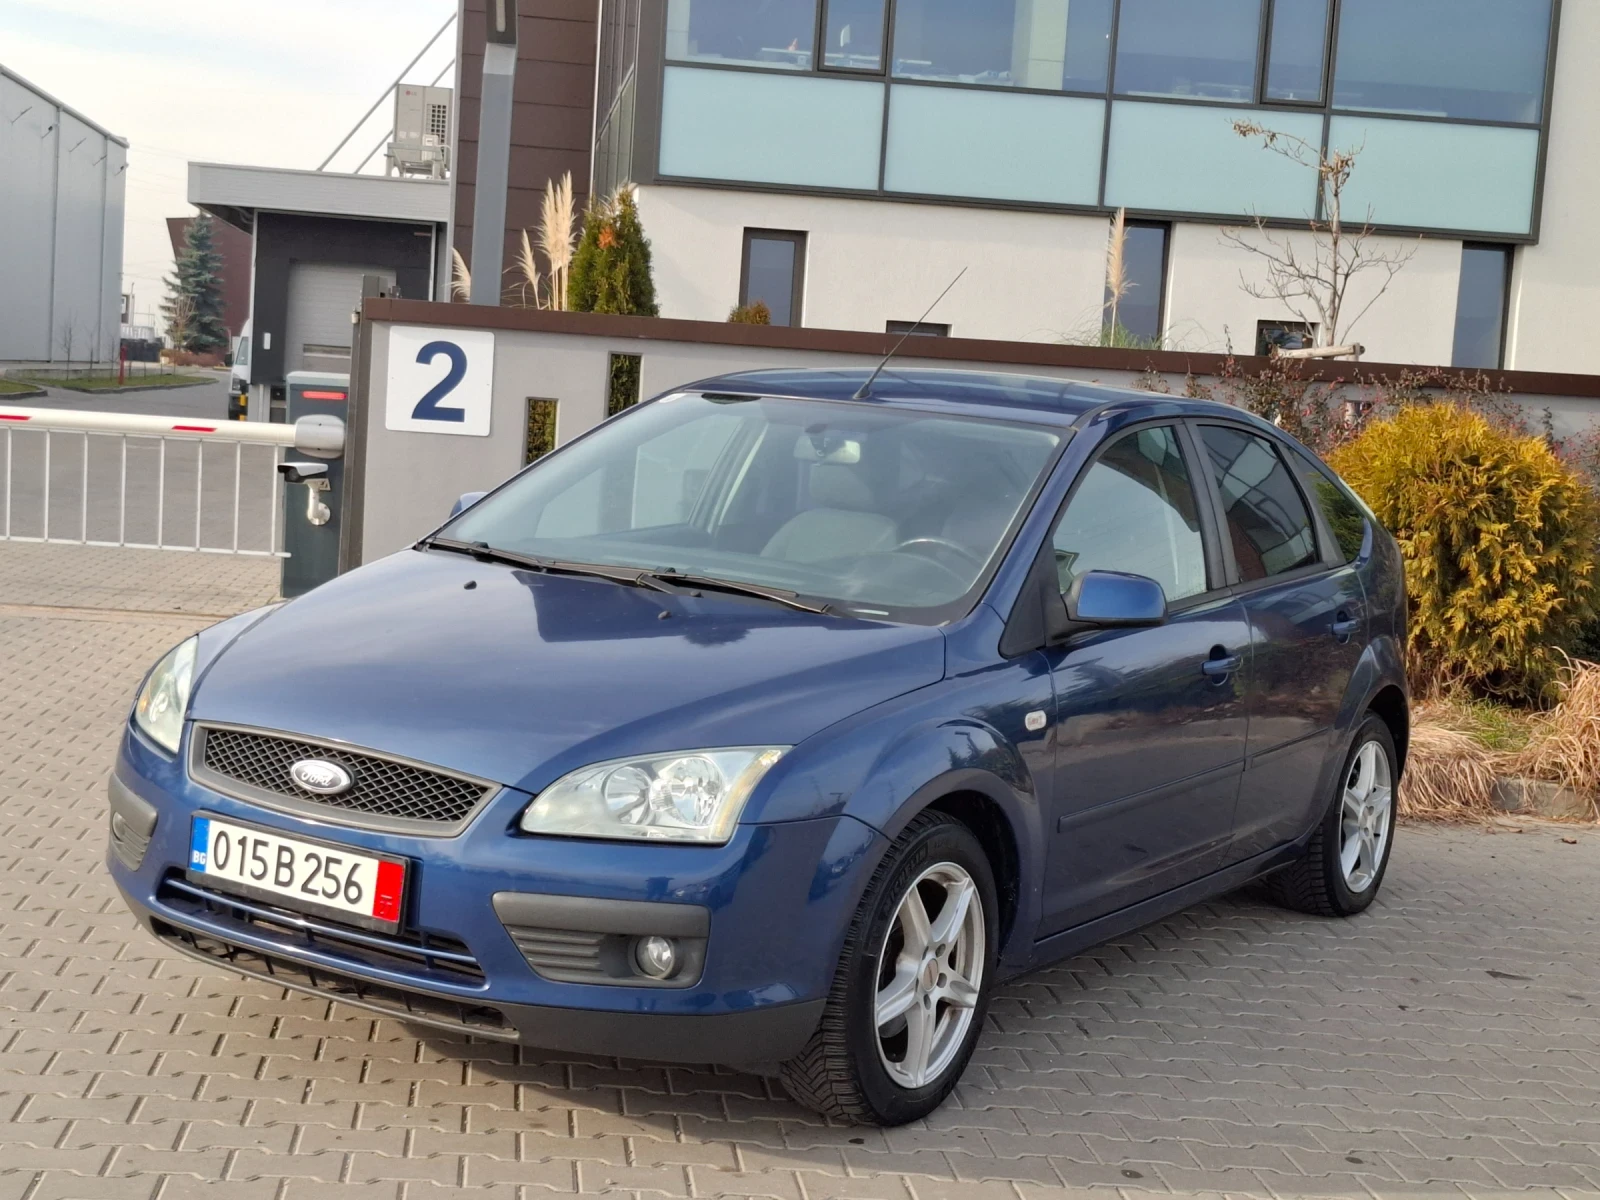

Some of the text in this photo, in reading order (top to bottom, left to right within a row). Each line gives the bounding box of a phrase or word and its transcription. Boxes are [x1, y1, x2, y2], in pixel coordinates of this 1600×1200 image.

[411, 340, 468, 422] 2
[193, 829, 363, 905] BG 015B256
